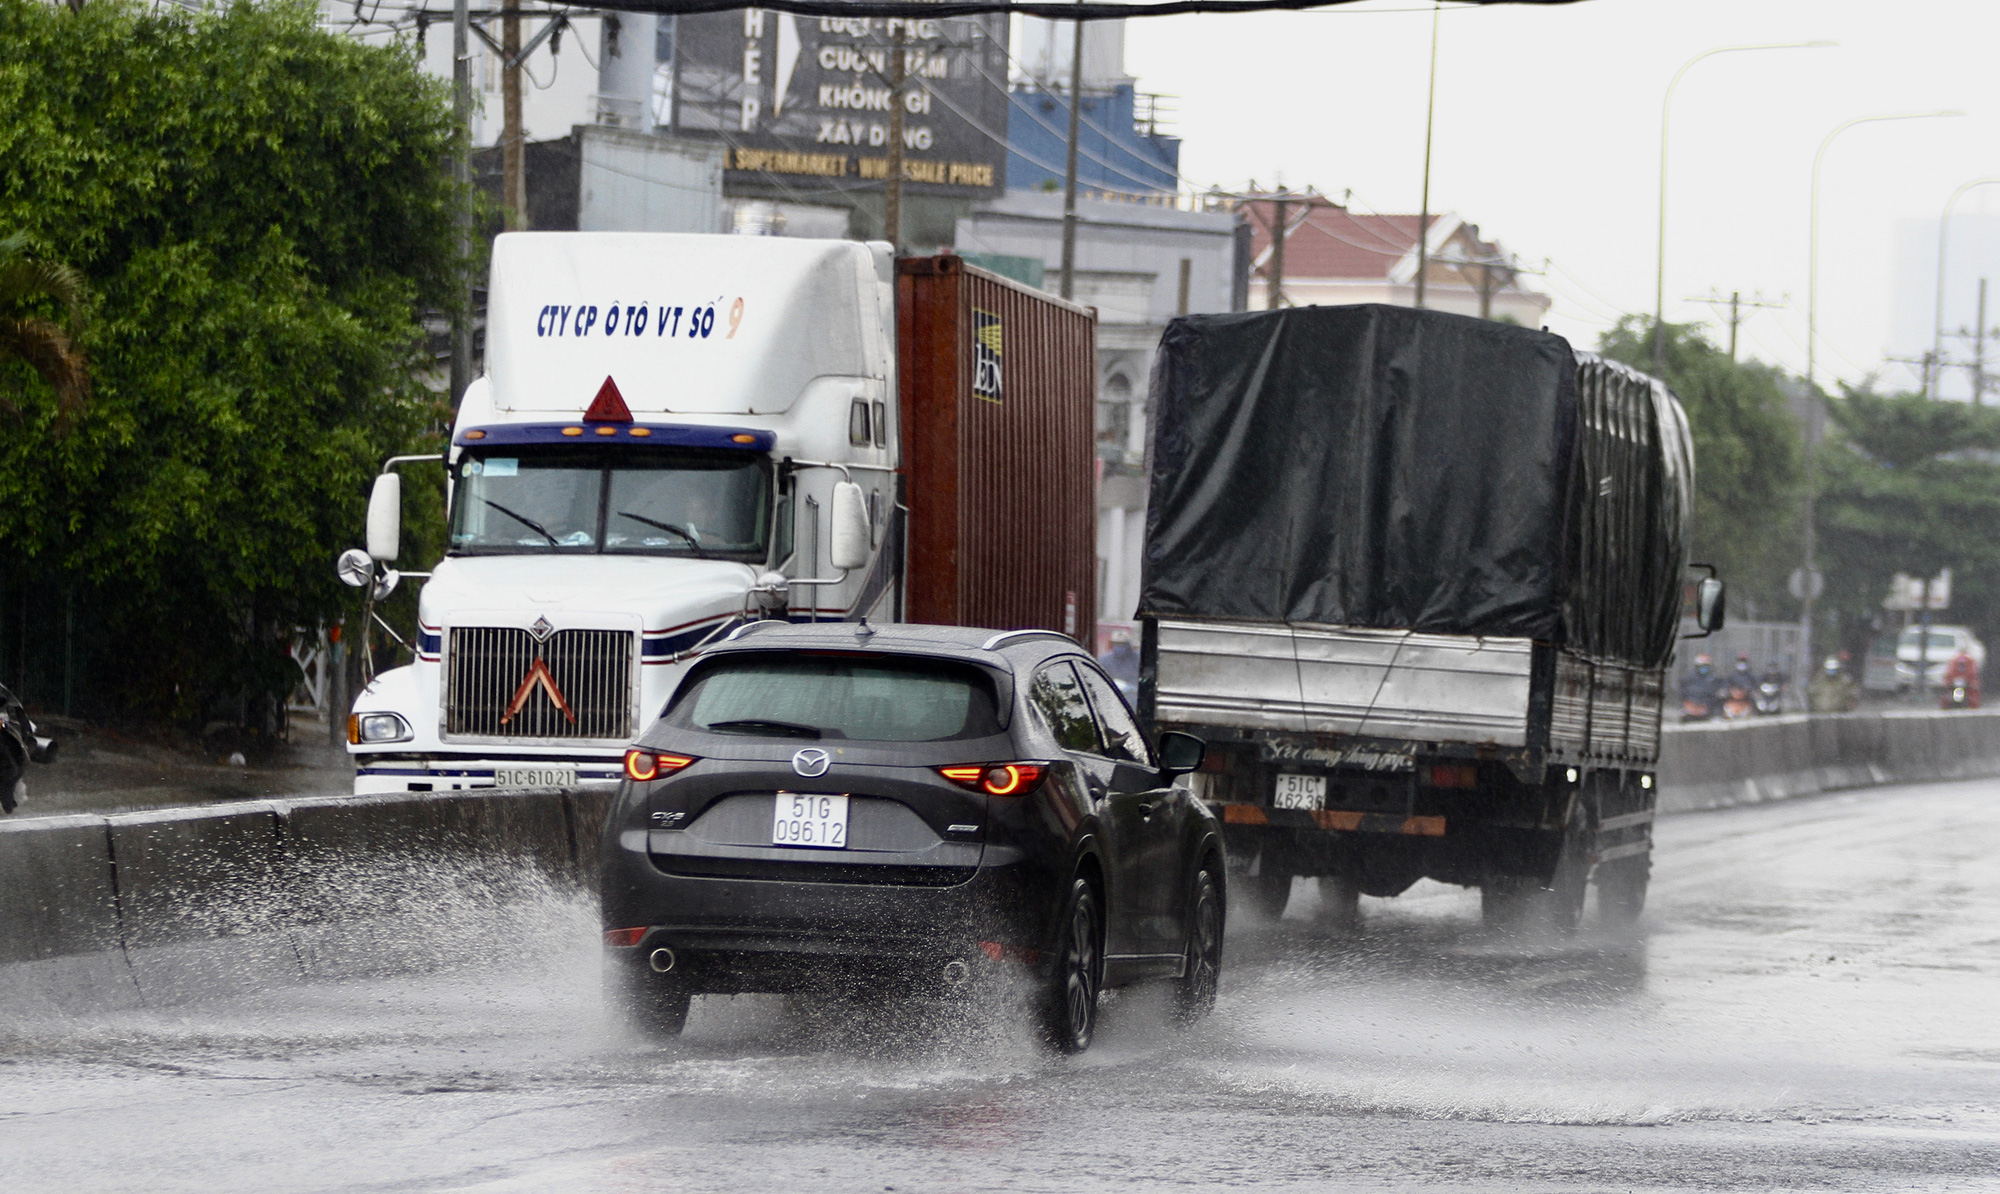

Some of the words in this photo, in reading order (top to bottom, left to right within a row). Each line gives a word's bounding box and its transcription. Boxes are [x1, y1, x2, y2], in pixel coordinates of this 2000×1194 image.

[735, 148, 848, 177] SUPERMARKET
[948, 162, 994, 187] PRICE
[537, 304, 572, 337] CTY
[574, 304, 598, 337] CP
[605, 299, 620, 336] Ô
[625, 300, 649, 337] TÔ
[689, 295, 724, 339] SỐ
[726, 297, 744, 339] 9
[1287, 776, 1316, 793] 51C
[793, 795, 831, 819] 51G
[776, 819, 843, 844] 096.12
